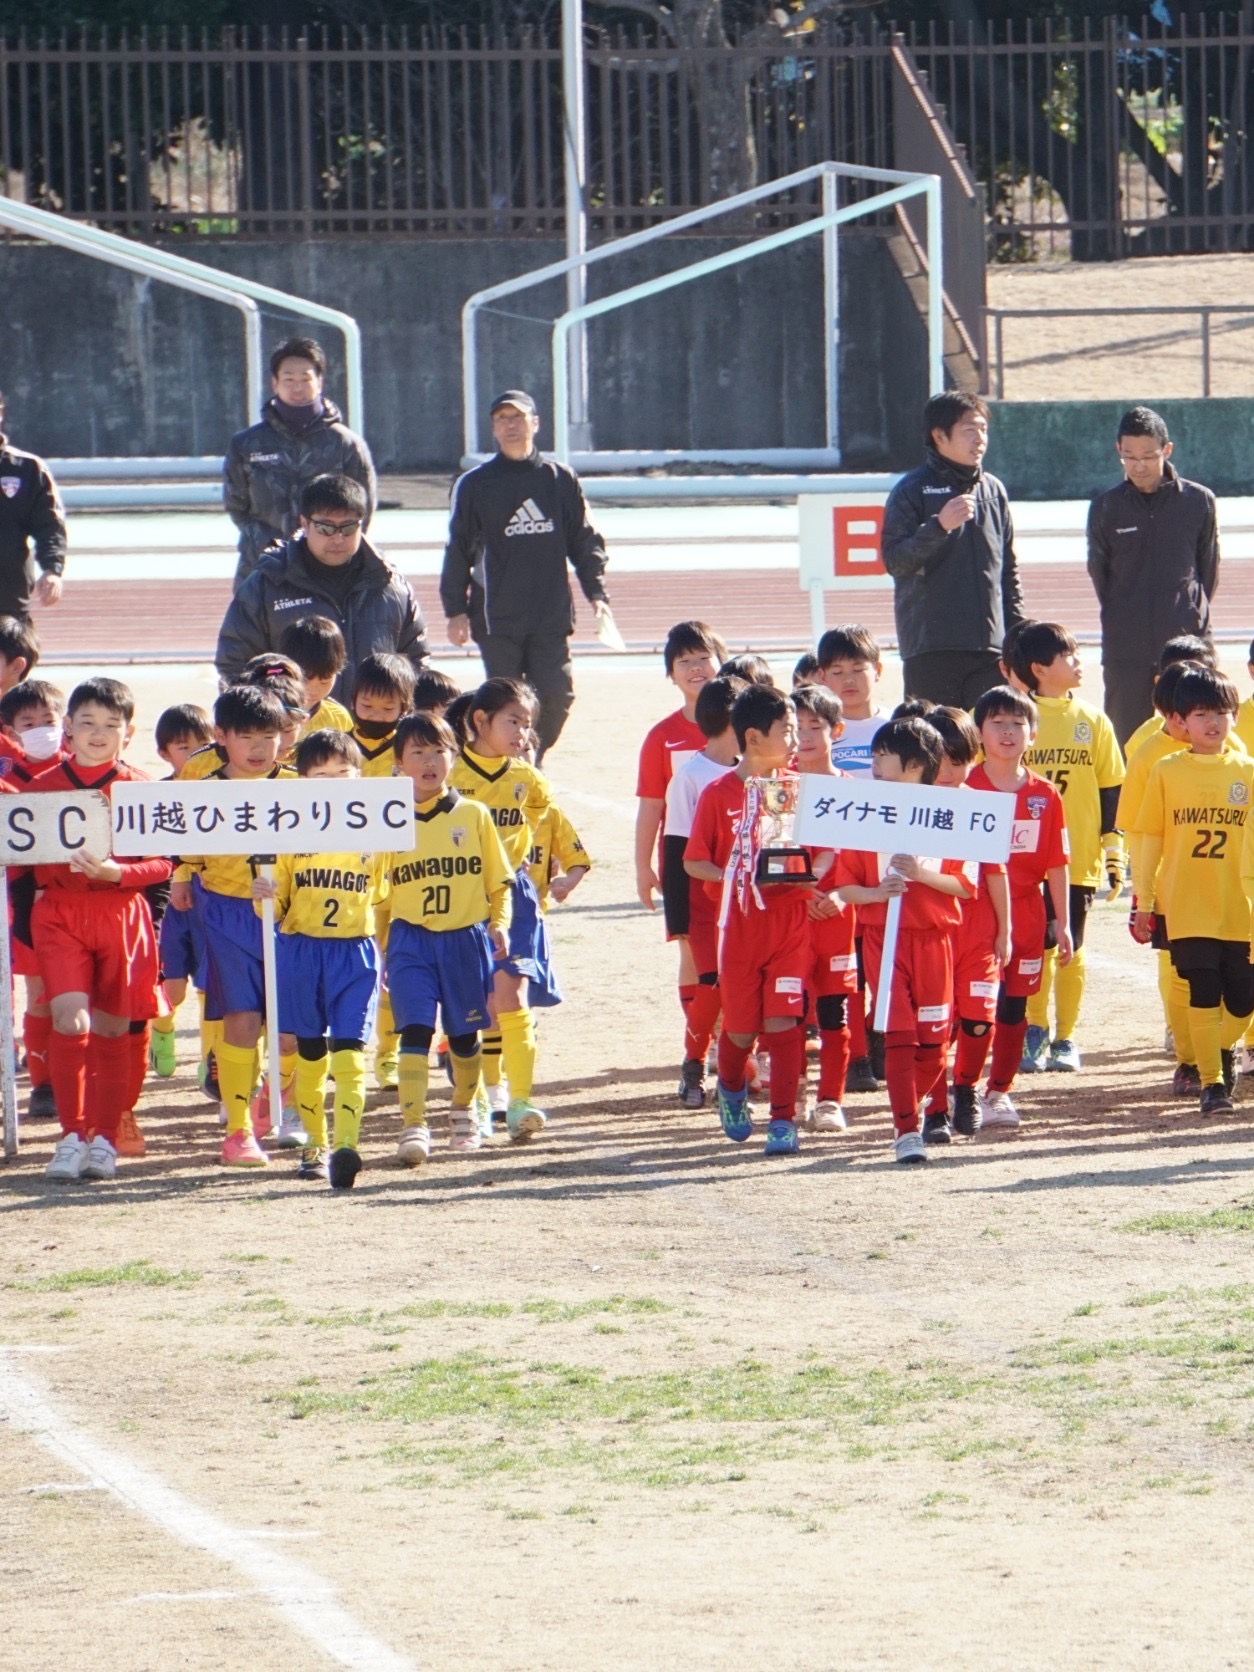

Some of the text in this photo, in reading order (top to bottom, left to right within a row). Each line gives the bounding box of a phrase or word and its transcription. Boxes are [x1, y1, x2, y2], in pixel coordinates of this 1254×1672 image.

[504, 519, 555, 537] adidas
[833, 505, 887, 577] B
[274, 597, 313, 611] ATHLETA
[832, 749, 868, 761] POCARI
[115, 799, 408, 835] 川越ひまわりSC
[814, 797, 997, 833] ダイナモ 川越 FC
[1191, 829, 1228, 860] 22
[322, 898, 340, 928] 2
[421, 885, 451, 917] 20
